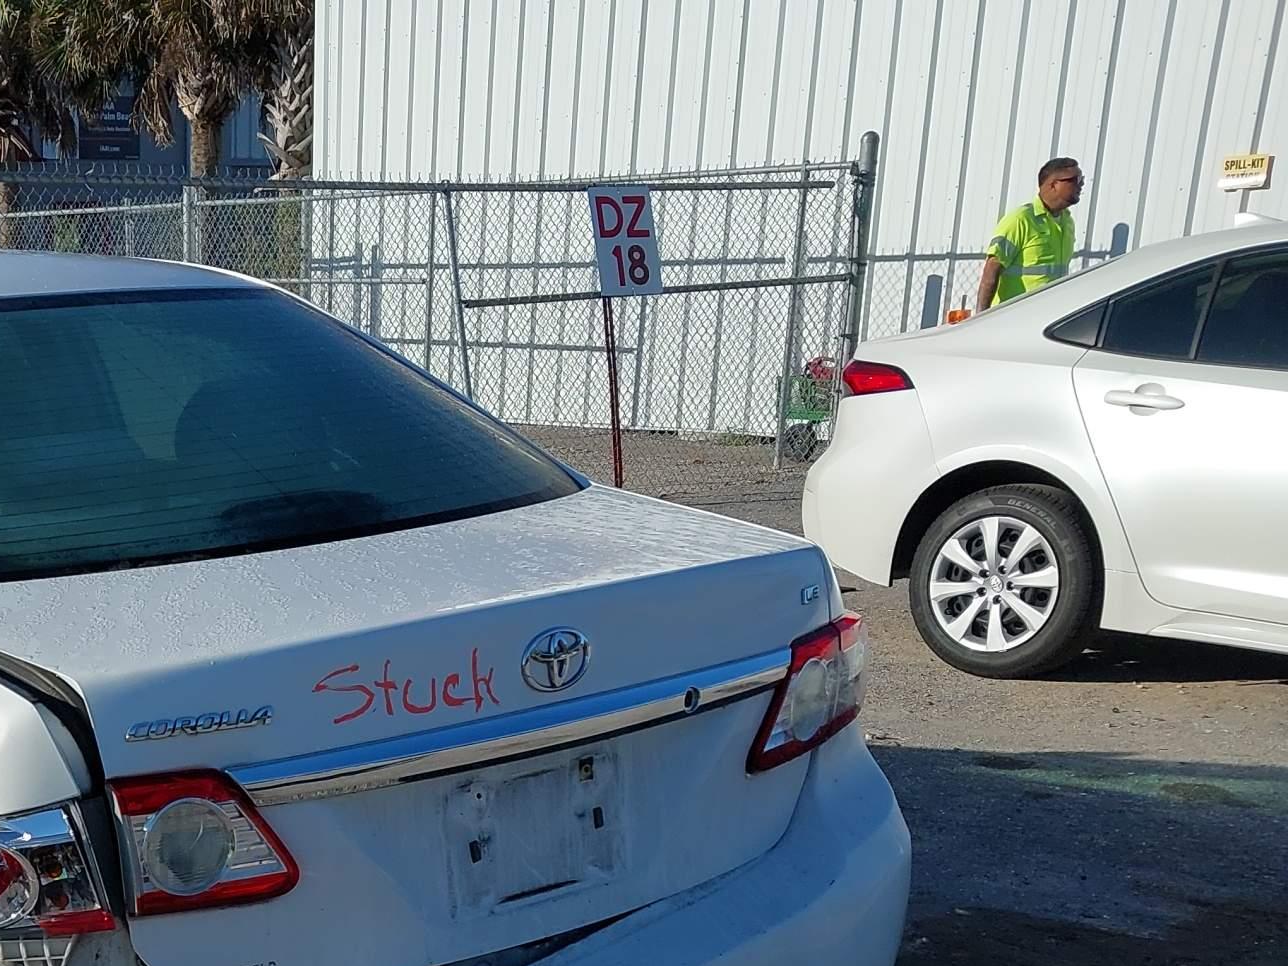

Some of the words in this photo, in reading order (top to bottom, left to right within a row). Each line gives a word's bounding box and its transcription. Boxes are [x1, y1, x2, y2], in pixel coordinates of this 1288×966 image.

[1225, 158, 1264, 170] SPILL-KIT
[595, 196, 650, 237] DZ
[612, 245, 649, 286] 18
[1007, 499, 1056, 528] GENERAL
[801, 586, 819, 605] LE
[312, 648, 500, 724] Stuck
[124, 705, 273, 742] COROLLA
